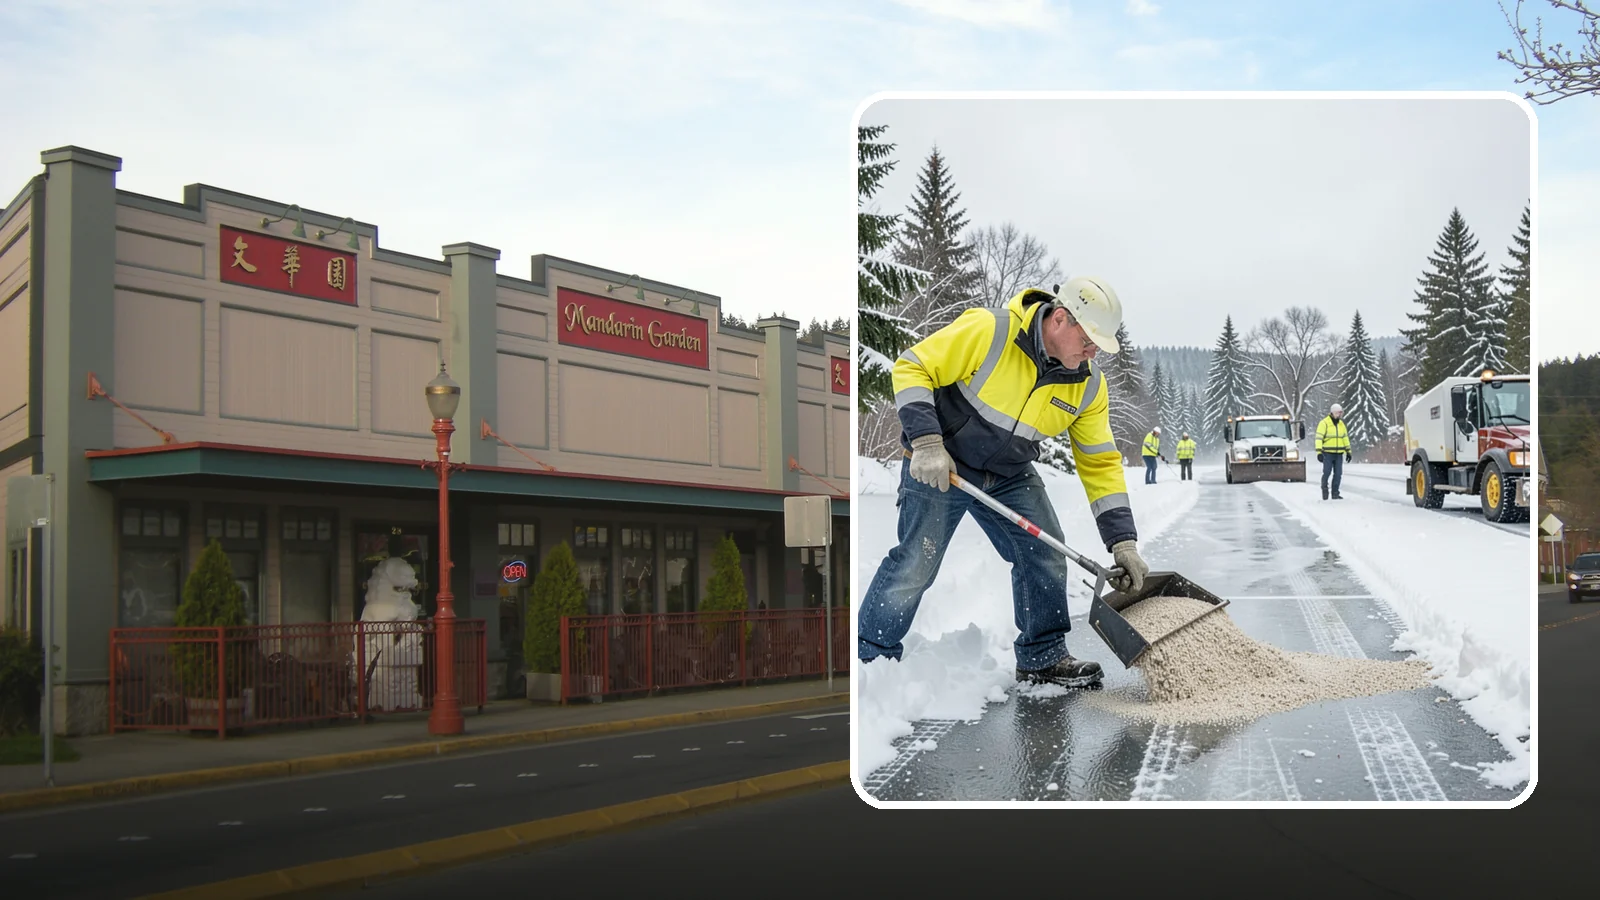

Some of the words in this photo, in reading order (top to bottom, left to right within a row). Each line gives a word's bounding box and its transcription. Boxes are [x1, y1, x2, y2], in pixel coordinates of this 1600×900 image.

[231, 235, 346, 291] 文華園
[565, 302, 644, 340] Mandarin
[648, 320, 701, 352] Garden
[503, 565, 527, 578] OPEN
